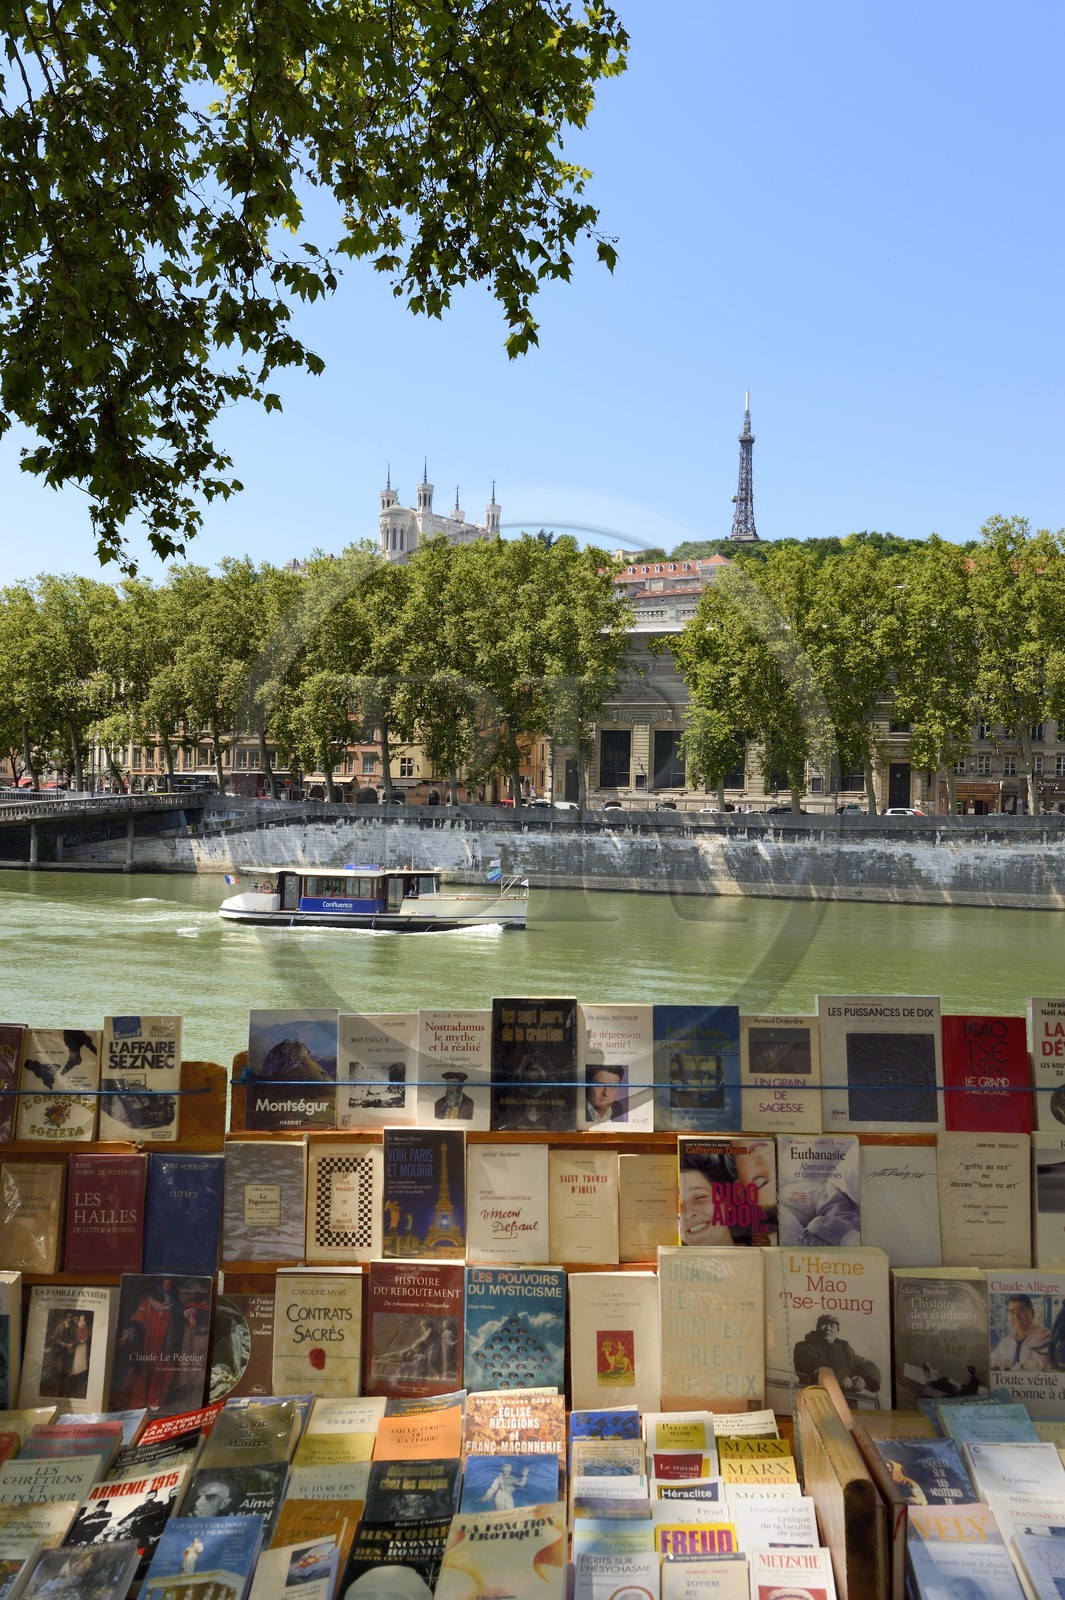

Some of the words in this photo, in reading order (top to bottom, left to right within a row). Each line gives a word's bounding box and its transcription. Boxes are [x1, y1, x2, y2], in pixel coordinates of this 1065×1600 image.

[828, 1008, 842, 1016] LES
[844, 1008, 900, 1017] PUISSANCES
[902, 1008, 914, 1017] DE
[917, 1008, 934, 1017] DIX
[426, 1022, 485, 1032] Nostradamus
[776, 1017, 804, 1025] Desjardins
[588, 1030, 598, 1038] La
[600, 1030, 643, 1040] dépression,
[964, 1021, 1008, 1038] MAO
[434, 1032, 443, 1042] le
[446, 1032, 476, 1044] mythe
[606, 1040, 626, 1048] sortir
[109, 1041, 175, 1054] L'AFFAIRE
[428, 1043, 438, 1052] et
[440, 1042, 449, 1052] la
[452, 1042, 481, 1052] réalité
[964, 1040, 1008, 1063] TSE
[108, 1055, 174, 1070] SEZNEC
[965, 1077, 976, 1087] LE
[978, 1077, 1010, 1087] GRAND
[774, 1091, 787, 1100] DE
[256, 1098, 329, 1116] Montségur
[759, 1102, 804, 1113] SAGESSE
[388, 1148, 406, 1162] VOIR
[410, 1148, 432, 1162] PARIS
[686, 1146, 722, 1154] Catherine
[790, 1147, 846, 1160] Euthanasie
[388, 1164, 398, 1177] ET
[400, 1164, 432, 1177] MOURIR
[560, 1174, 578, 1183] SAINT
[583, 1174, 608, 1184] THOMAS
[572, 1186, 596, 1194] D'AQUIN
[712, 1183, 758, 1205] DICO
[74, 1193, 100, 1206] LES
[74, 1210, 137, 1224] HALLES
[480, 1208, 522, 1220] Vincent
[712, 1204, 750, 1226] ADO
[789, 1256, 864, 1275] L'Herne
[395, 1276, 440, 1286] HISTOIRE
[472, 1272, 492, 1283] LES
[498, 1273, 558, 1284] POUVOIRS
[806, 1276, 846, 1292] Mao
[374, 1287, 390, 1295] DU
[391, 1288, 461, 1298] REBOUTEMENT
[468, 1284, 485, 1295] DU
[489, 1286, 562, 1298] MYSTICISME
[991, 1281, 1023, 1291] Claude
[1026, 1281, 1060, 1293] Allègre
[780, 1292, 873, 1314] Tse-toung
[912, 1298, 956, 1308] L'histoire
[286, 1304, 352, 1322] CONTRATS
[912, 1310, 928, 1318] des
[930, 1310, 977, 1320] étudiants
[912, 1322, 923, 1330] en
[926, 1321, 960, 1330] France
[292, 1325, 344, 1343] SACRÉS
[129, 1352, 158, 1362] Claude
[160, 1353, 170, 1362] Le
[172, 1353, 204, 1362] Peletier
[993, 1373, 1024, 1386] Toute
[1028, 1374, 1058, 1386] vérité
[1012, 1388, 1046, 1400] bonne
[1049, 1390, 1056, 1400] à
[162, 1414, 203, 1428] VICTOIRE
[490, 1418, 540, 1429] RELIGIONS
[510, 1431, 520, 1440] et
[724, 1442, 784, 1453] MARX
[36, 1466, 58, 1476] LES
[728, 1462, 790, 1475] MARX
[30, 1486, 46, 1494] ET
[89, 1482, 148, 1500] ARMENIE
[150, 1471, 180, 1492] 1915
[380, 1478, 400, 1490] chez
[402, 1478, 416, 1490] les
[12, 1493, 76, 1502] POUVOIR
[662, 1488, 712, 1498] Héraclite
[239, 1498, 274, 1508] Aimé
[486, 1516, 554, 1532] FONCTION
[778, 1516, 810, 1524] Critique
[790, 1530, 812, 1538] juger
[661, 1530, 733, 1554] FREUD
[759, 1554, 820, 1570] NIETZSCHE
[580, 1564, 652, 1573] L'HÉSYCHASME
